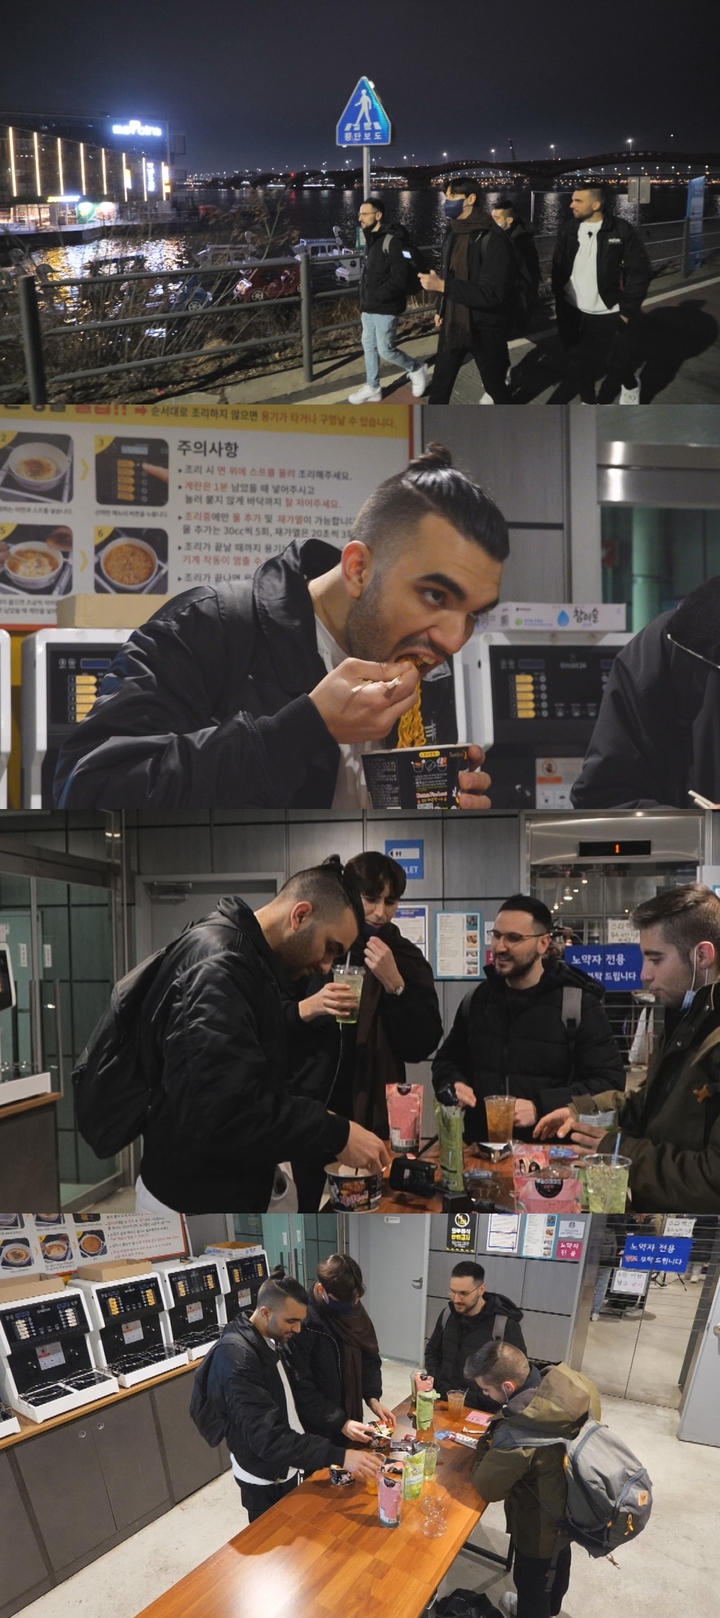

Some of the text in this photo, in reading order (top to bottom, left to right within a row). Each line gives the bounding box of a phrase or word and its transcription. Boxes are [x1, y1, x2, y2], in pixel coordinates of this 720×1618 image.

[344, 131, 382, 141] 횡단보도
[151, 406, 397, 428] 순서대로 조리하지 않으면 용기가 타거나 구멍날 수 있습니다.
[98, 439, 104, 447] 3
[177, 440, 239, 459] 주의사항
[185, 465, 352, 481] 조리 시 면 위에 스프를 올려 조리해주세요.
[185, 481, 315, 495] 계란은 1분 남았을 때 넣어주시고
[205, 495, 223, 505] 붙지
[226, 495, 245, 506] 않게
[246, 496, 282, 507] 바닥까지
[284, 497, 293, 508] 잘
[295, 498, 342, 509] 저어주세요.
[185, 512, 230, 523] 조리중에만
[232, 513, 241, 523] 물
[244, 513, 261, 523] 추가
[264, 514, 273, 524] 및
[277, 514, 312, 525] 재가열이
[97, 529, 104, 538] 6
[182, 525, 191, 535] 물
[194, 525, 220, 535] 추가는
[223, 526, 253, 536] 30cc씩
[256, 527, 272, 537] 5회,
[274, 528, 309, 538] 재가열은
[311, 529, 339, 539] 20초씩
[184, 542, 211, 552] 조리가
[214, 542, 232, 552] 끝날
[235, 543, 261, 553] 때까지
[182, 555, 262, 566] 기계 작동이 멈출 수
[184, 573, 211, 583] 조리가
[573, 606, 599, 624] 참이슬
[615, 844, 620, 854] 1
[571, 953, 626, 966] 노약자 전용
[605, 971, 637, 982] 드립니다
[560, 1242, 579, 1250] 노약자
[630, 1242, 676, 1254] 노약자 전용
[640, 1256, 654, 1264] 부탁
[655, 1257, 683, 1266] 드립니다
